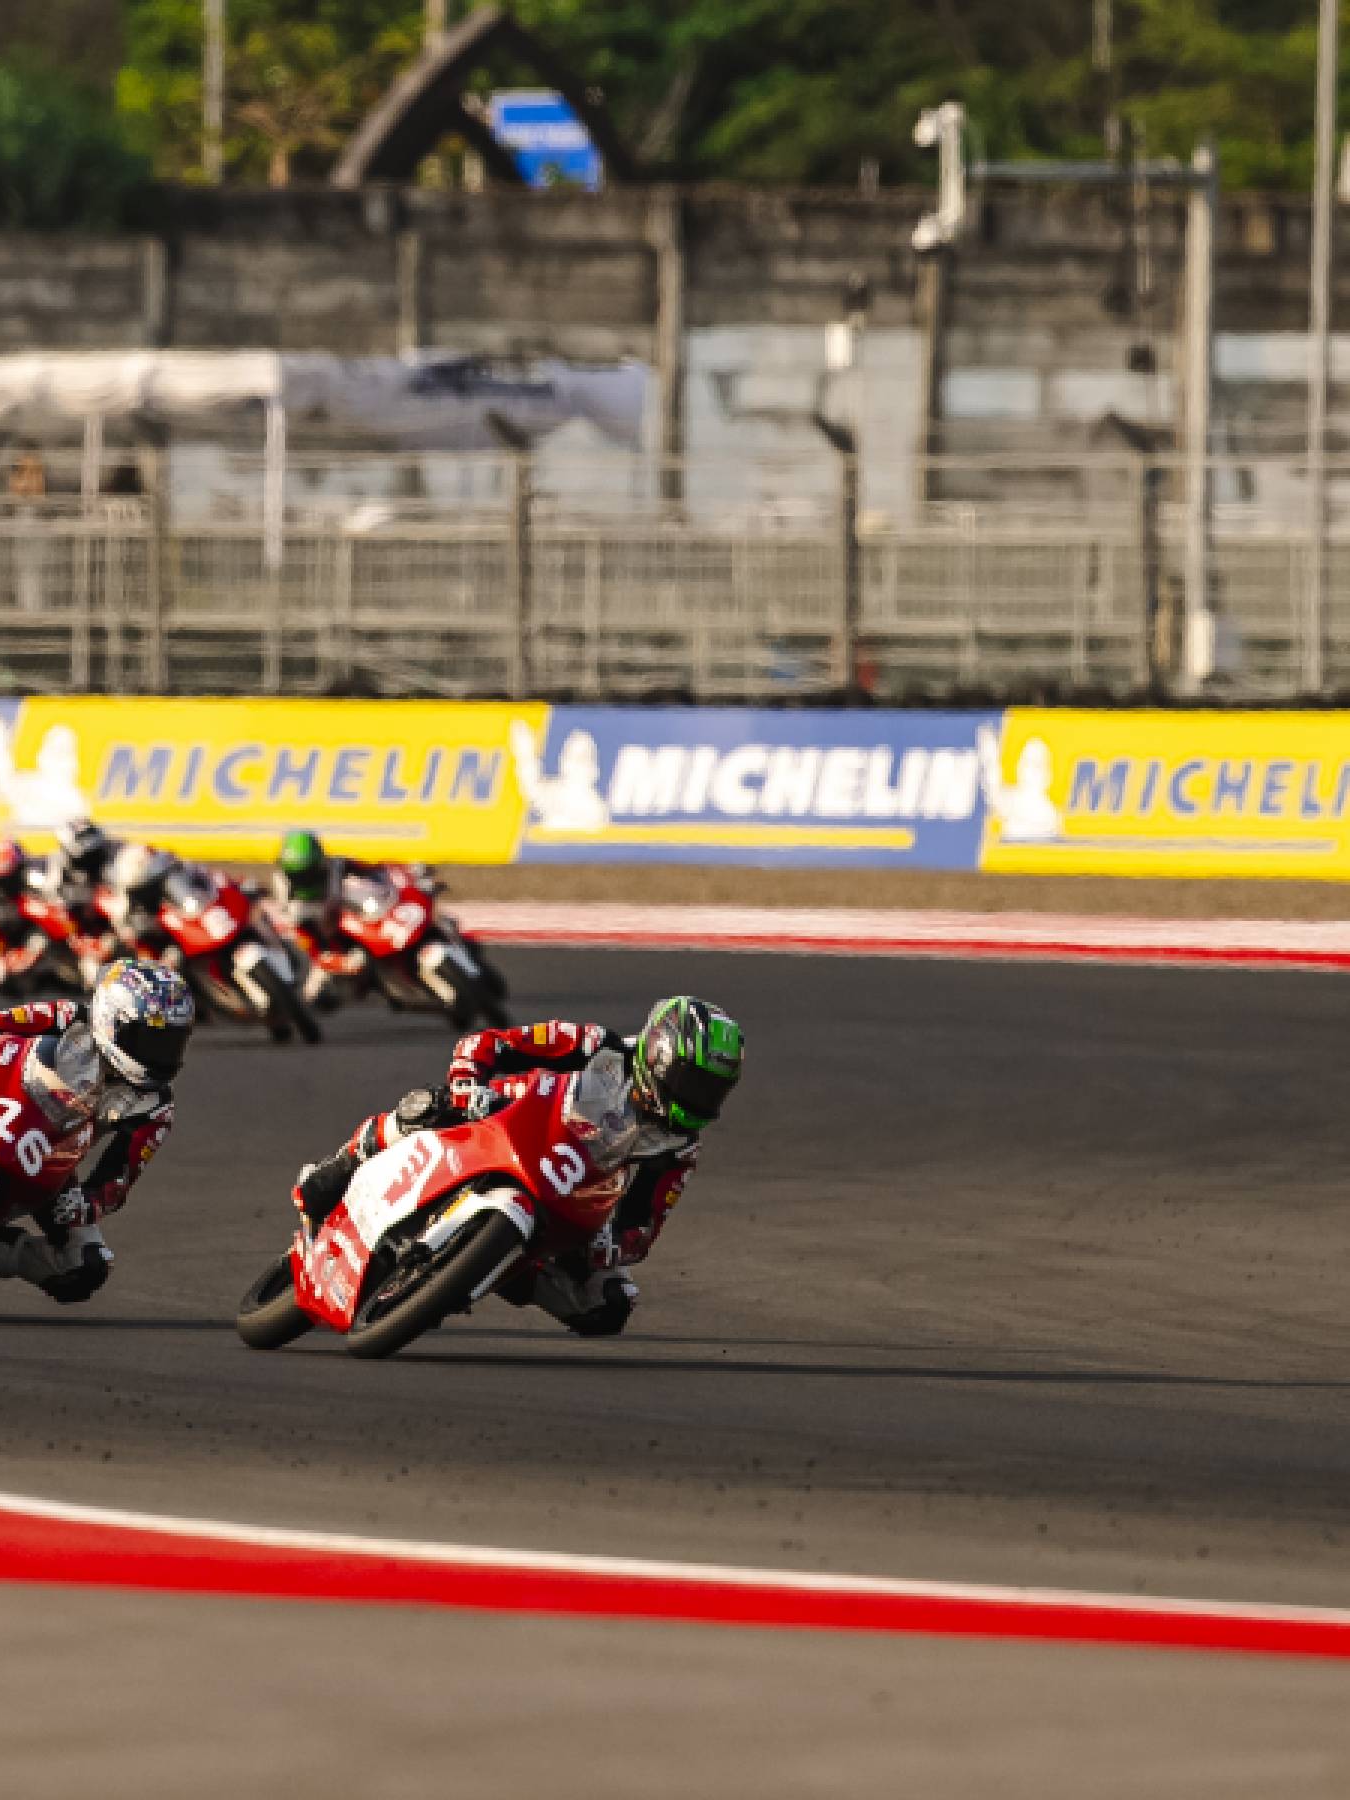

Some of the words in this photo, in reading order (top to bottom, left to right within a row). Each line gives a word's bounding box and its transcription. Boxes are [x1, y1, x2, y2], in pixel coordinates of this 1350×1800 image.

[98, 746, 503, 800] MICHELIN
[610, 745, 979, 820] MICHELIN
[540, 1143, 585, 1194] 3
